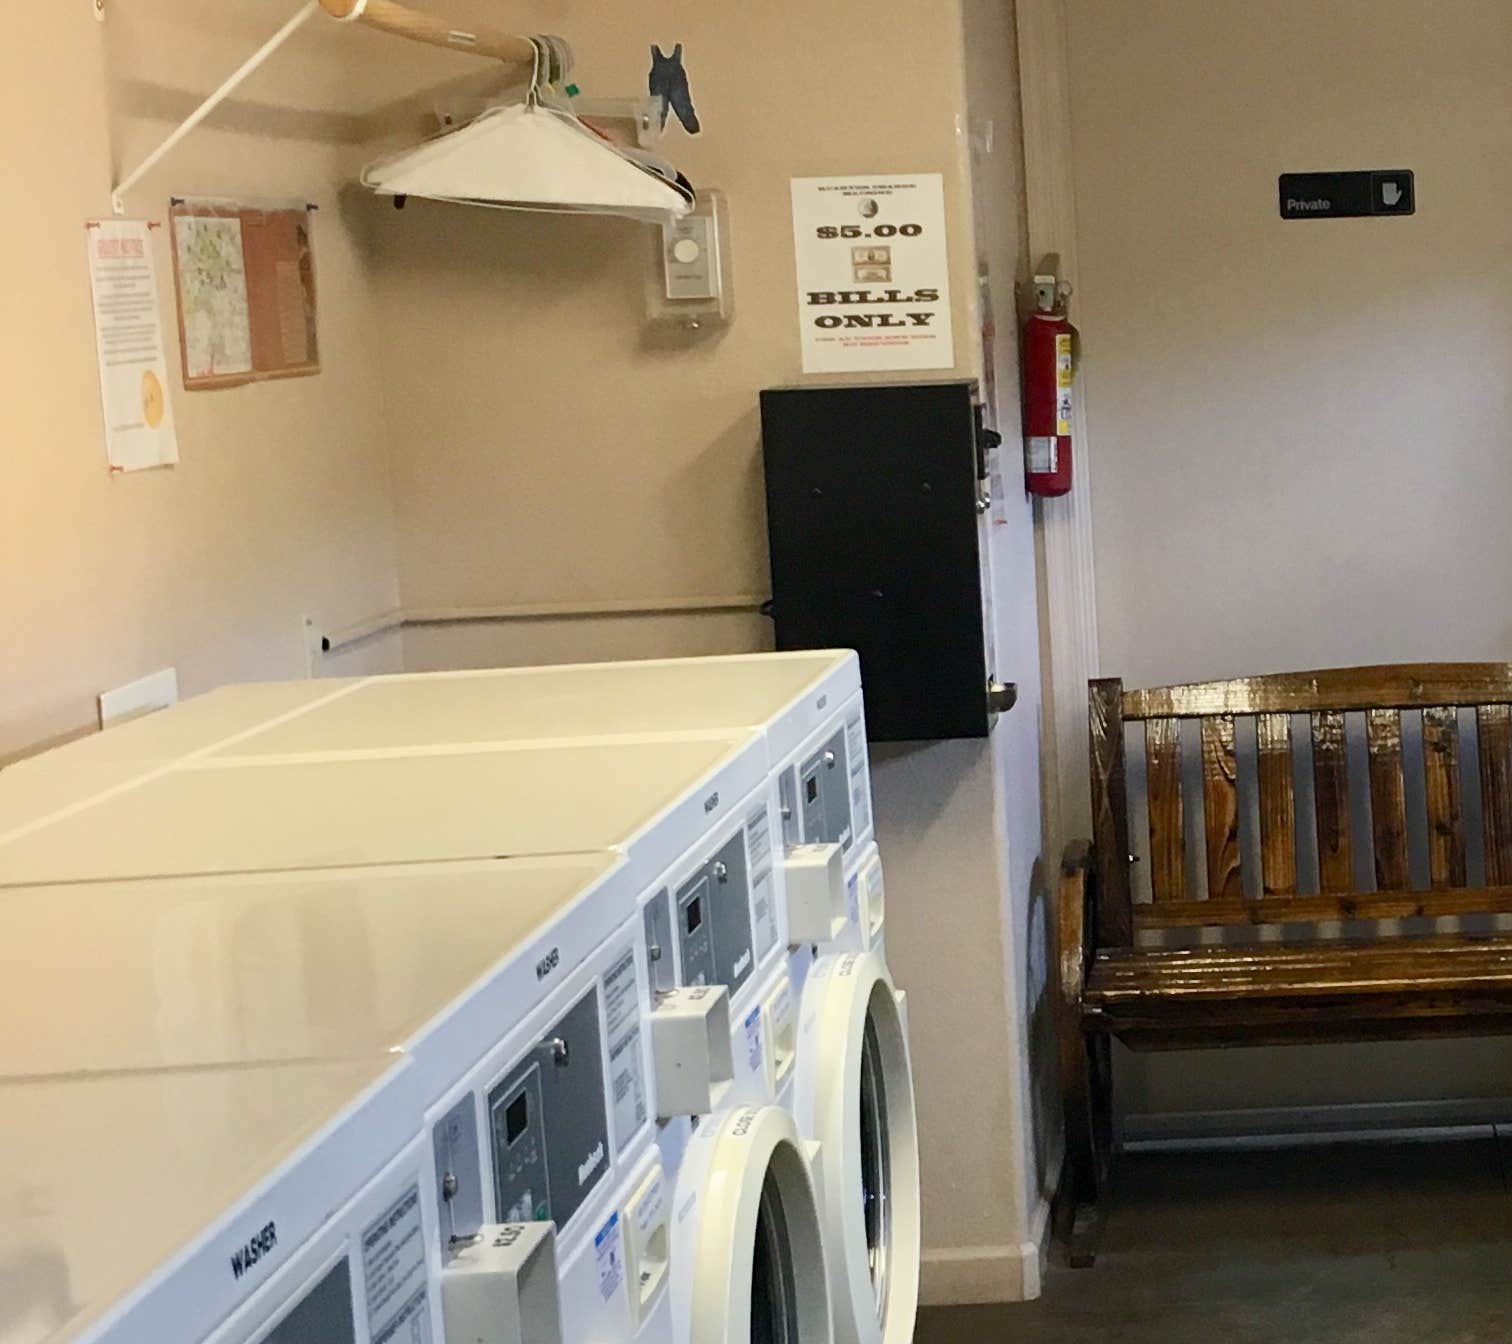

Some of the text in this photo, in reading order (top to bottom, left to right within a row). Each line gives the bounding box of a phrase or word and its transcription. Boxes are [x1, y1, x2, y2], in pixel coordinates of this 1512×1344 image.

[1287, 198, 1331, 211] Private
[816, 223, 923, 240] $5.00
[806, 288, 939, 306] BILLS
[814, 312, 935, 329] ONLY
[231, 1221, 277, 1280] WASHER
